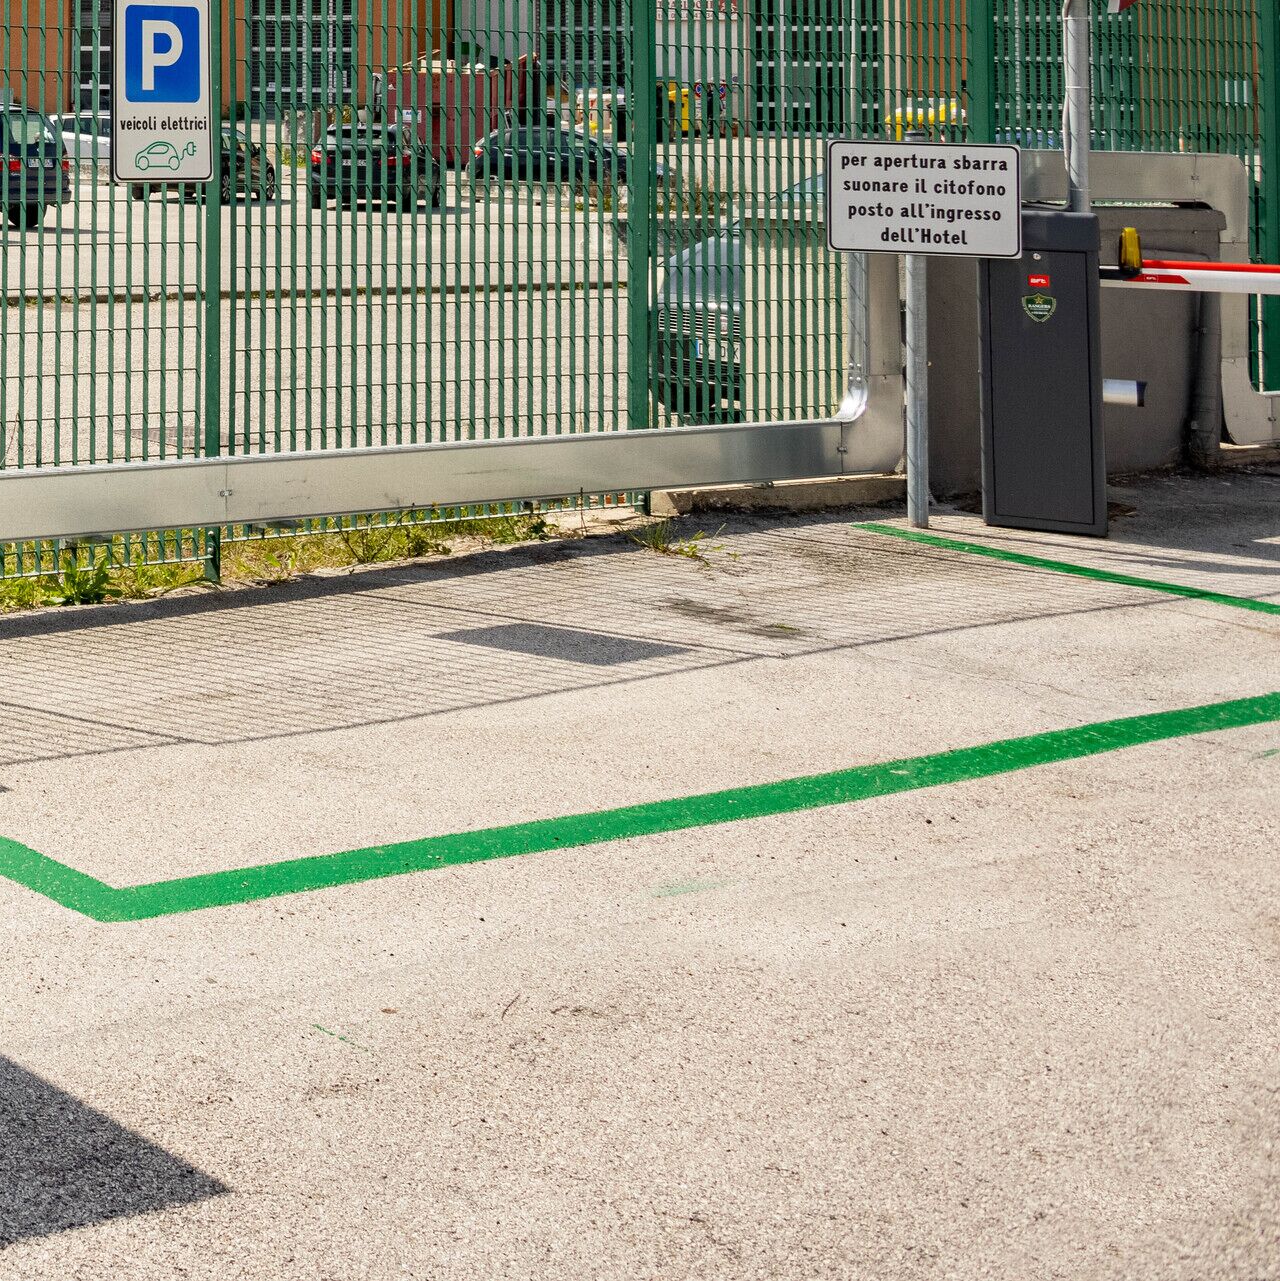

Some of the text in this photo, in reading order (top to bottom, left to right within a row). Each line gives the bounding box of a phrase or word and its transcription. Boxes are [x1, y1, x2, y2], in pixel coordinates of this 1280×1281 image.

[142, 19, 183, 91] P
[120, 116, 207, 131] veicoli elettrici
[841, 154, 1007, 171] per apertura sbarra
[843, 179, 1006, 196] suonare il citofono
[848, 203, 1001, 223] posto all'ingresso
[880, 227, 968, 245] dell'Hotel
